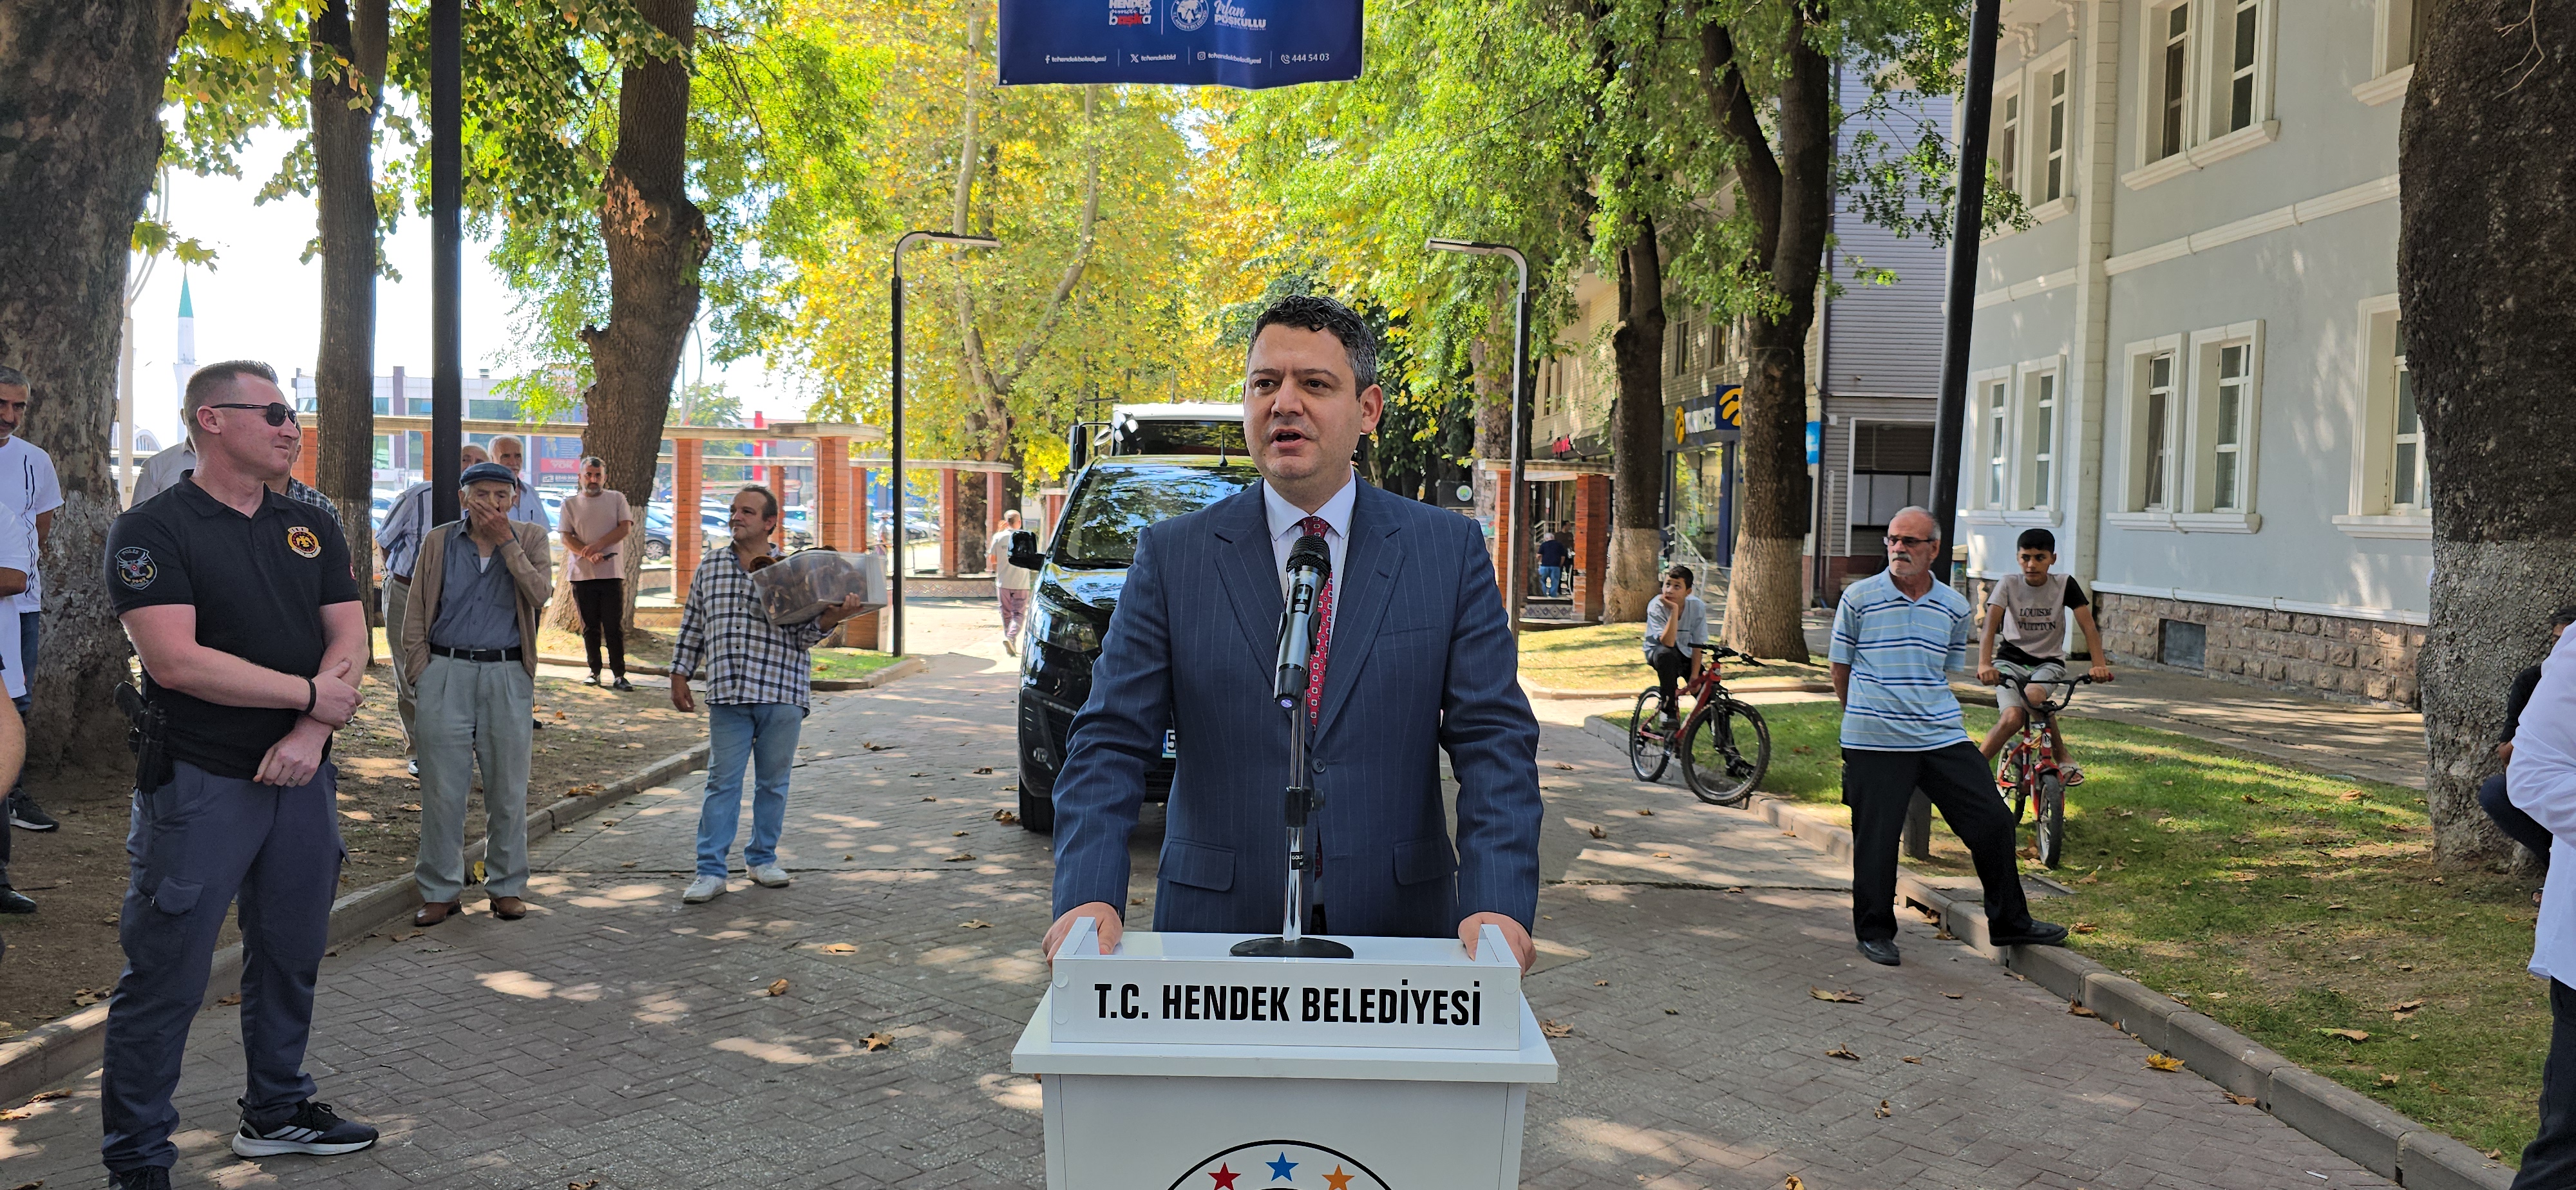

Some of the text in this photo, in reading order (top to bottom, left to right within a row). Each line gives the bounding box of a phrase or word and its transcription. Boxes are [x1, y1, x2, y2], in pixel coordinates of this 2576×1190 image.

[1292, 54, 1306, 62] 444
[2018, 621, 2056, 631] VUITTON
[1095, 979, 1481, 1026] T.C. HENDEK BELEDİYESİ
